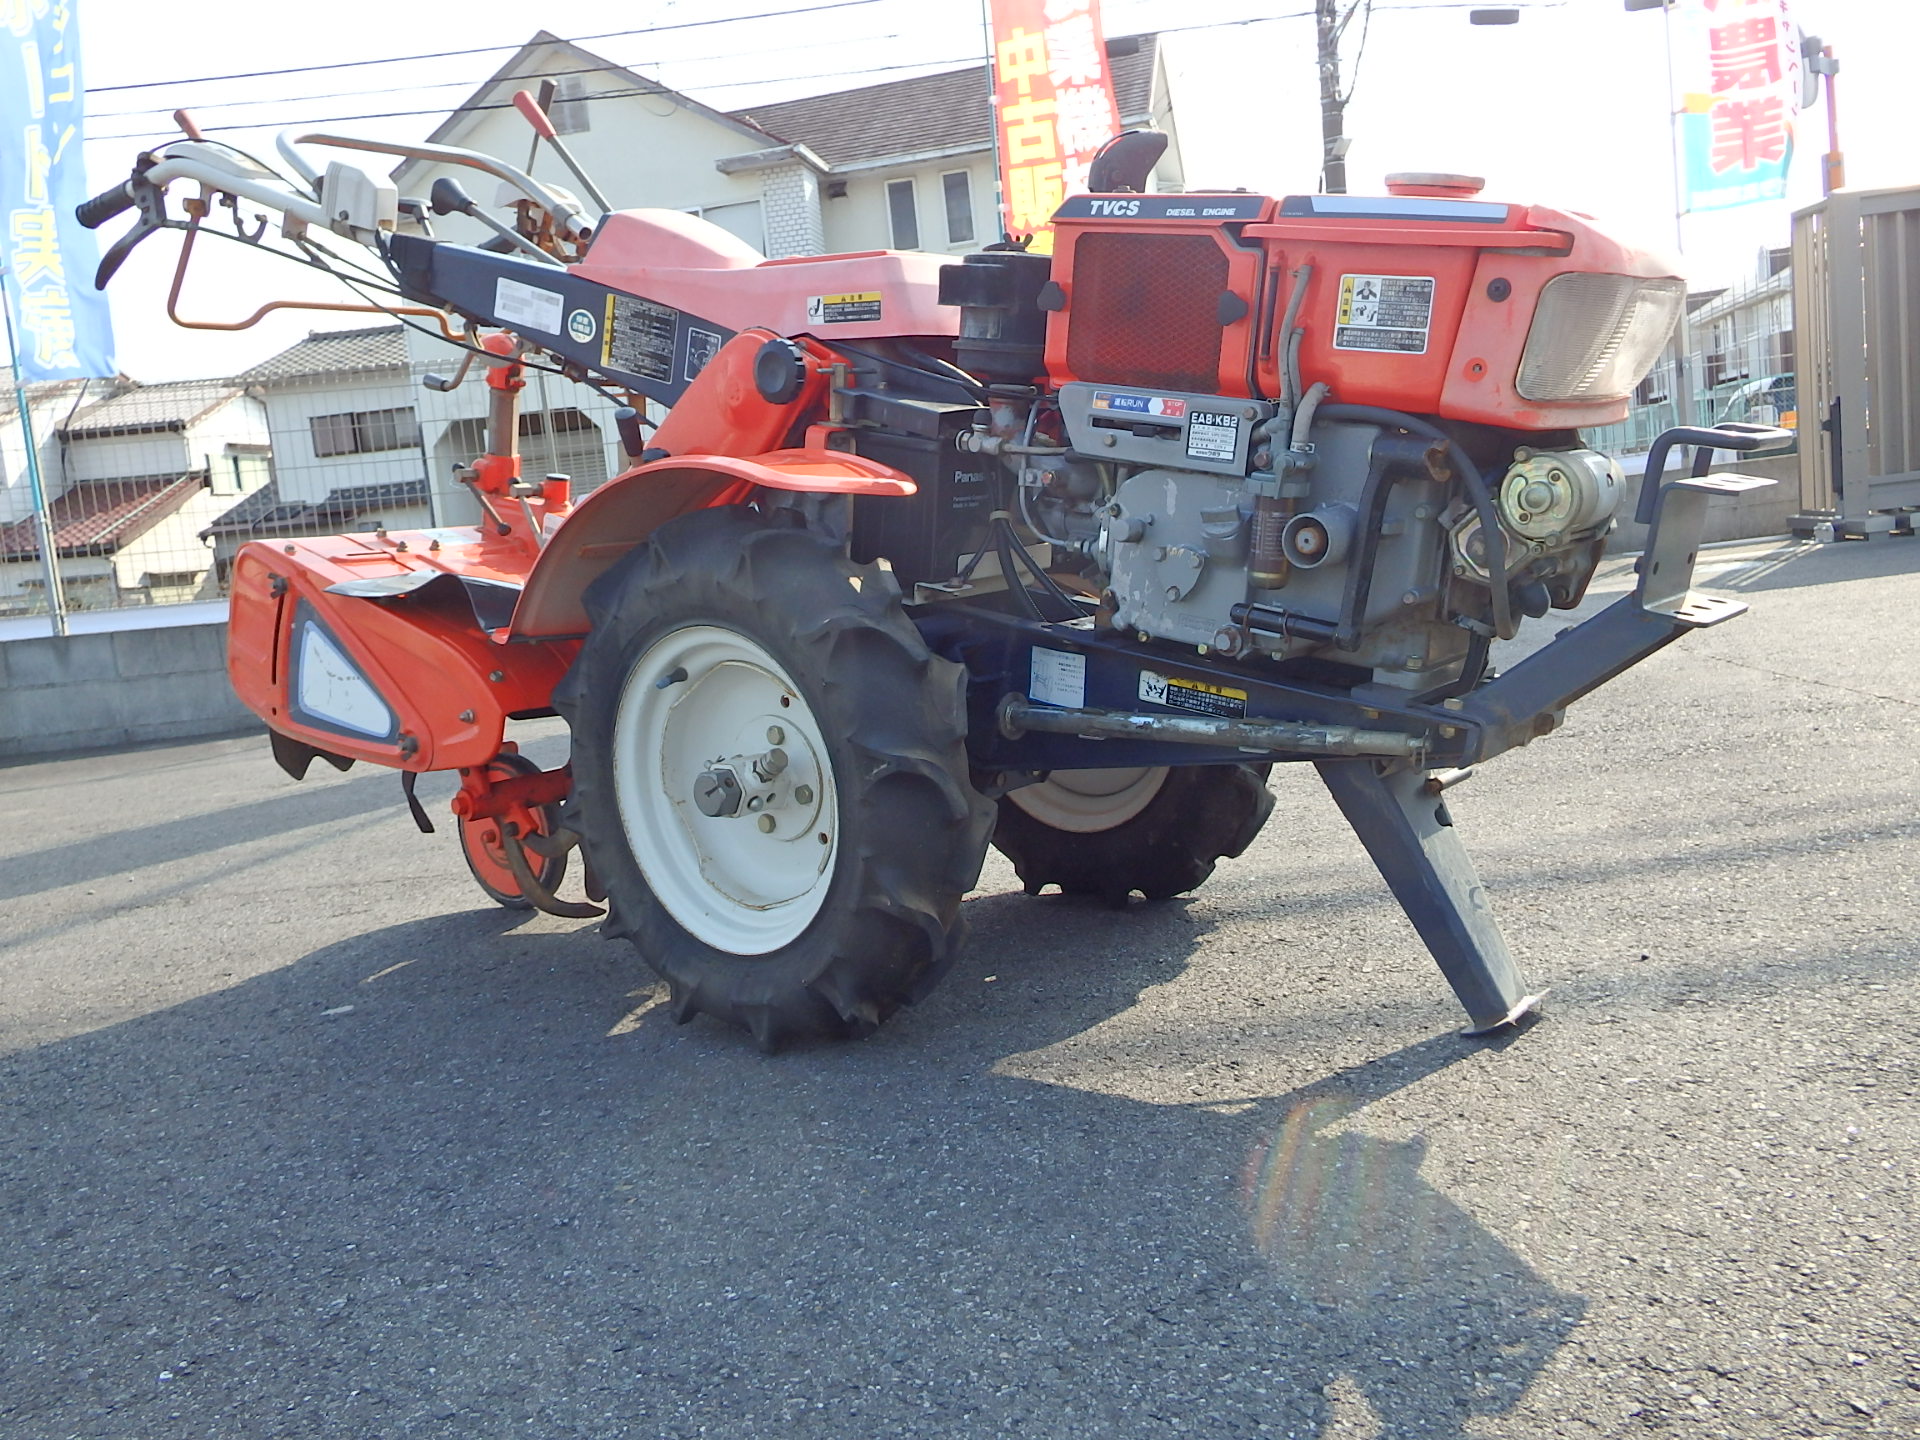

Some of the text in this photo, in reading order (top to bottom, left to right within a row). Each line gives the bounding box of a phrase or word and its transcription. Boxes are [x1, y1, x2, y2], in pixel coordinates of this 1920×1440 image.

[1089, 200, 1141, 217] TVCS
[1166, 208, 1236, 217] DIESEL ENGINE
